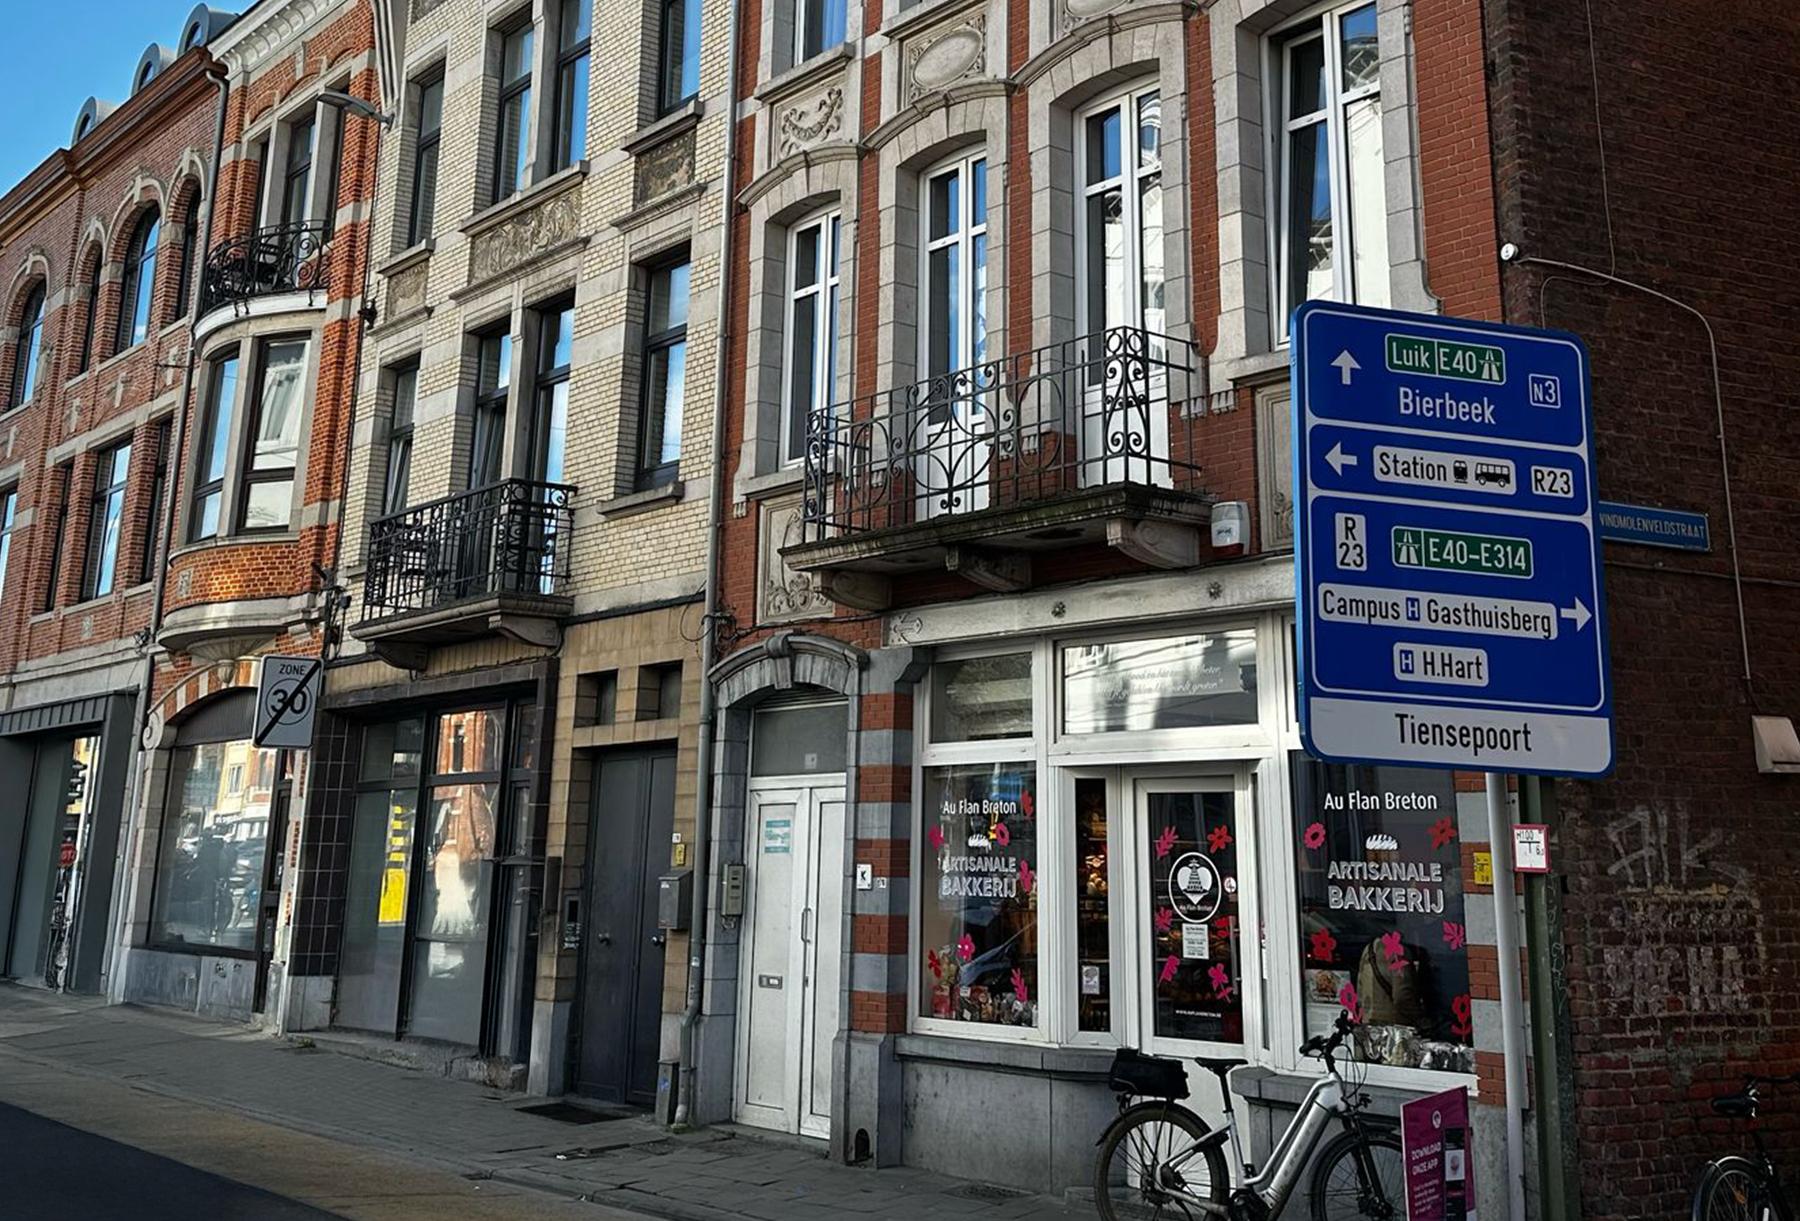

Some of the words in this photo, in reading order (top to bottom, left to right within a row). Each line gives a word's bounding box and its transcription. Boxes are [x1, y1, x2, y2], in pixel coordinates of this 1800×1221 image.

[1392, 341, 1430, 369] Luik
[1439, 348, 1477, 374] E40
[1533, 380, 1556, 403] N3
[1399, 386, 1496, 424] Bierbeek
[1379, 452, 1447, 482] Station
[1534, 469, 1571, 495] R23
[1344, 516, 1356, 541] R
[1339, 543, 1364, 567] 23
[1428, 538, 1527, 570] E40-E314
[1323, 590, 1400, 624] Campus
[1427, 599, 1552, 639] Gasthuisberg
[280, 664, 306, 675] ZONE
[1423, 651, 1483, 680] H.Hart
[271, 689, 307, 714] 30
[1395, 713, 1532, 756] Tiensepoort
[943, 800, 956, 814] Au
[958, 799, 980, 814] Flan
[982, 800, 1017, 814] Breton
[1324, 792, 1344, 810] Au
[1349, 790, 1380, 810] Flan
[1385, 792, 1437, 810] Breton
[942, 856, 1017, 873] ARTISANALE
[1327, 861, 1443, 882] ARTISANALE
[941, 876, 1017, 898] BAKKERIJ
[1328, 886, 1444, 913] BAKKERIJ
